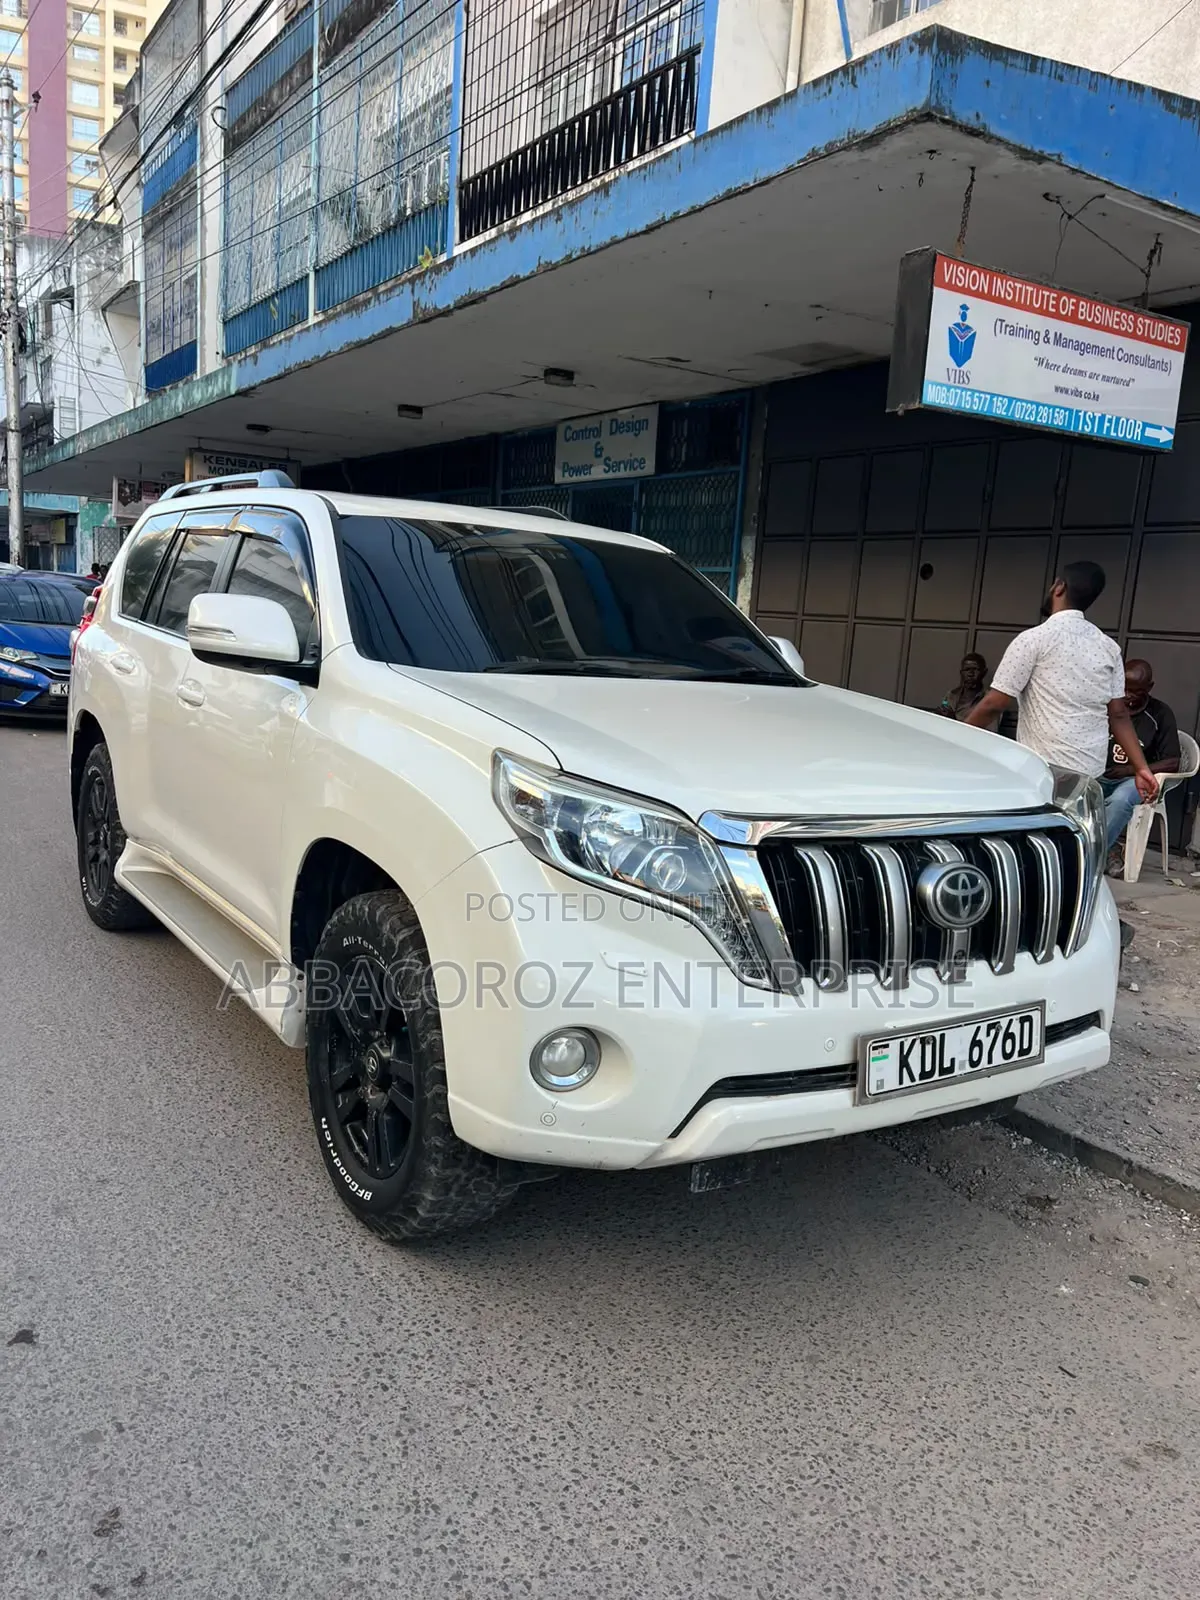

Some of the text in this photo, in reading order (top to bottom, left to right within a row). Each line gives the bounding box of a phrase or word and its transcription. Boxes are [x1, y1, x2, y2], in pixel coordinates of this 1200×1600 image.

[944, 261, 1181, 346] VISION INSTITUTE OF BUSINESS STUDIES
[993, 318, 1172, 376] (Training & Management Consultants)
[946, 368, 971, 385] VIBS
[1061, 363, 1088, 379] dreams
[1088, 371, 1101, 381] are
[1054, 385, 1100, 402] www.vibsco.ke
[972, 392, 991, 412] 577
[992, 395, 1009, 415] 152
[1014, 401, 1037, 421] 0723
[1036, 405, 1053, 425] 281
[1053, 408, 1069, 427] 581
[1078, 408, 1143, 440] 1ST FLOOR
[564, 415, 649, 442] Control Design
[594, 441, 604, 458] &
[562, 453, 647, 478] Power Service
[899, 1014, 1034, 1086] KDL 676D
[321, 1116, 373, 1201] BFGoodrich
